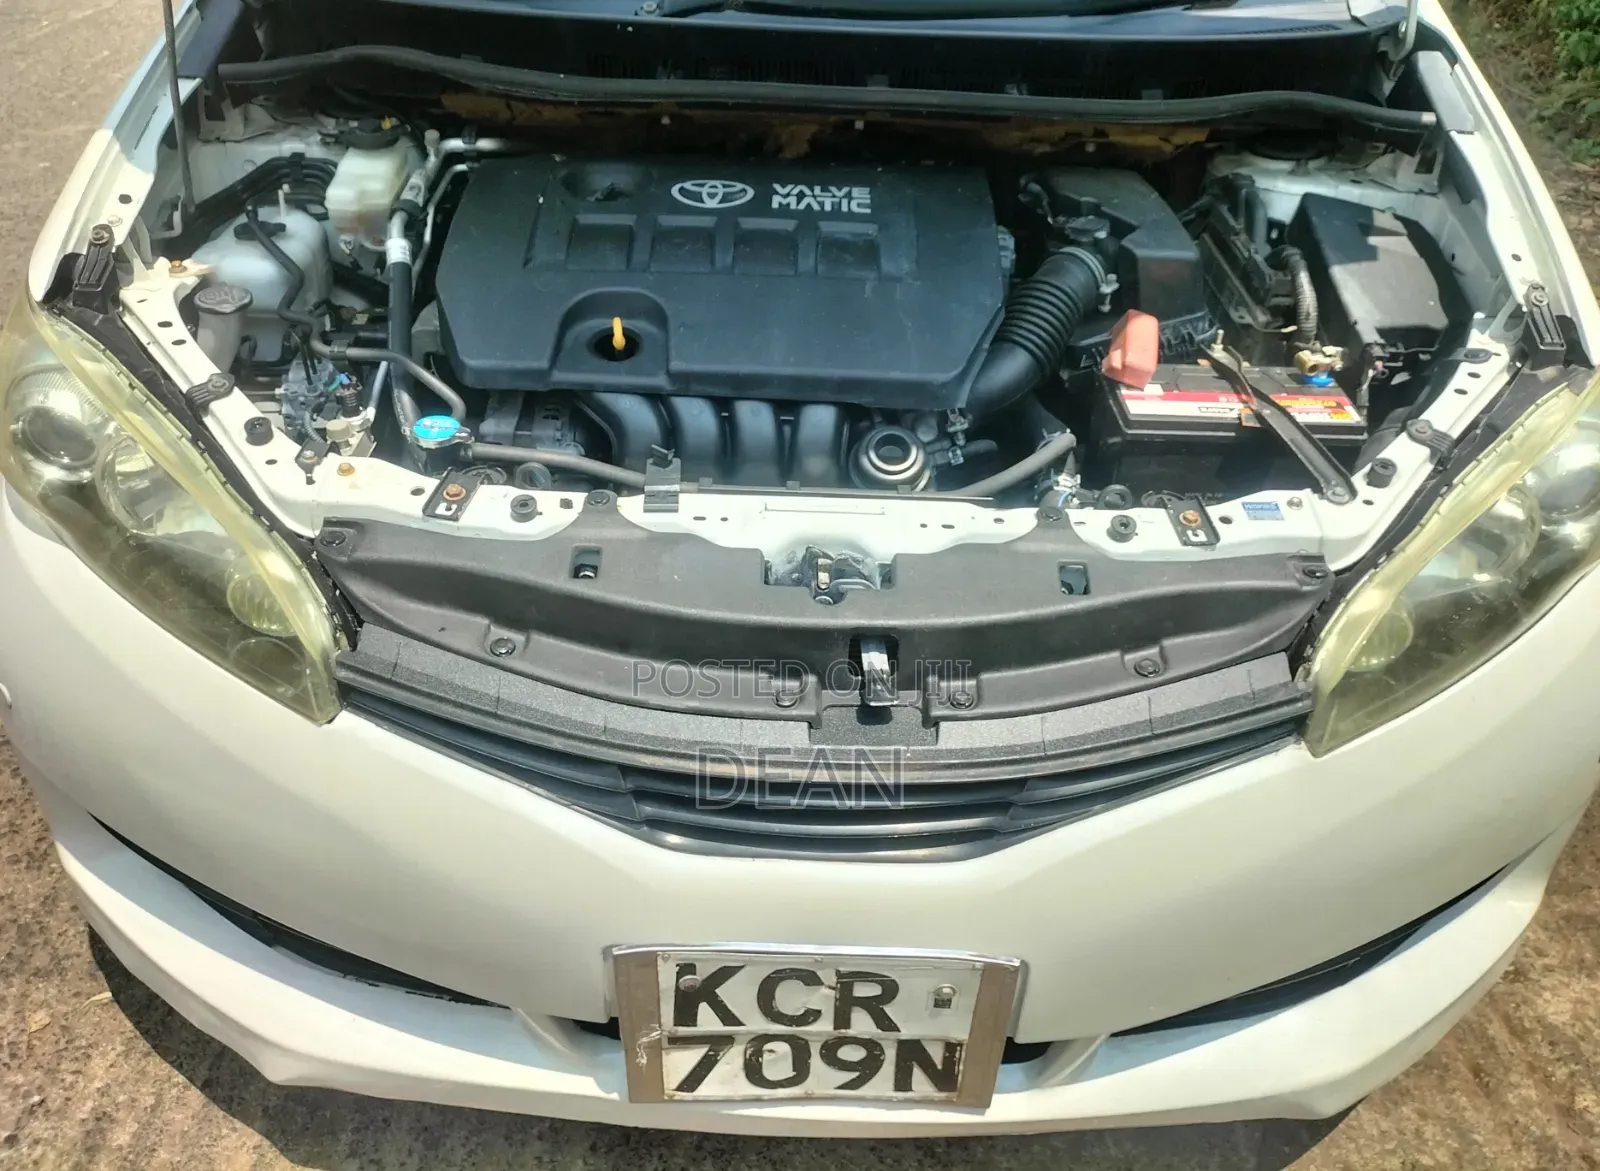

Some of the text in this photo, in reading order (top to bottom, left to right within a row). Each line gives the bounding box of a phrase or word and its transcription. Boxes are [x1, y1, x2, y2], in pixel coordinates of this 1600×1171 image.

[771, 183, 872, 199] VALVE
[771, 195, 872, 214] MATIC
[673, 962, 902, 1033] KCR
[667, 1033, 963, 1093] 709N
